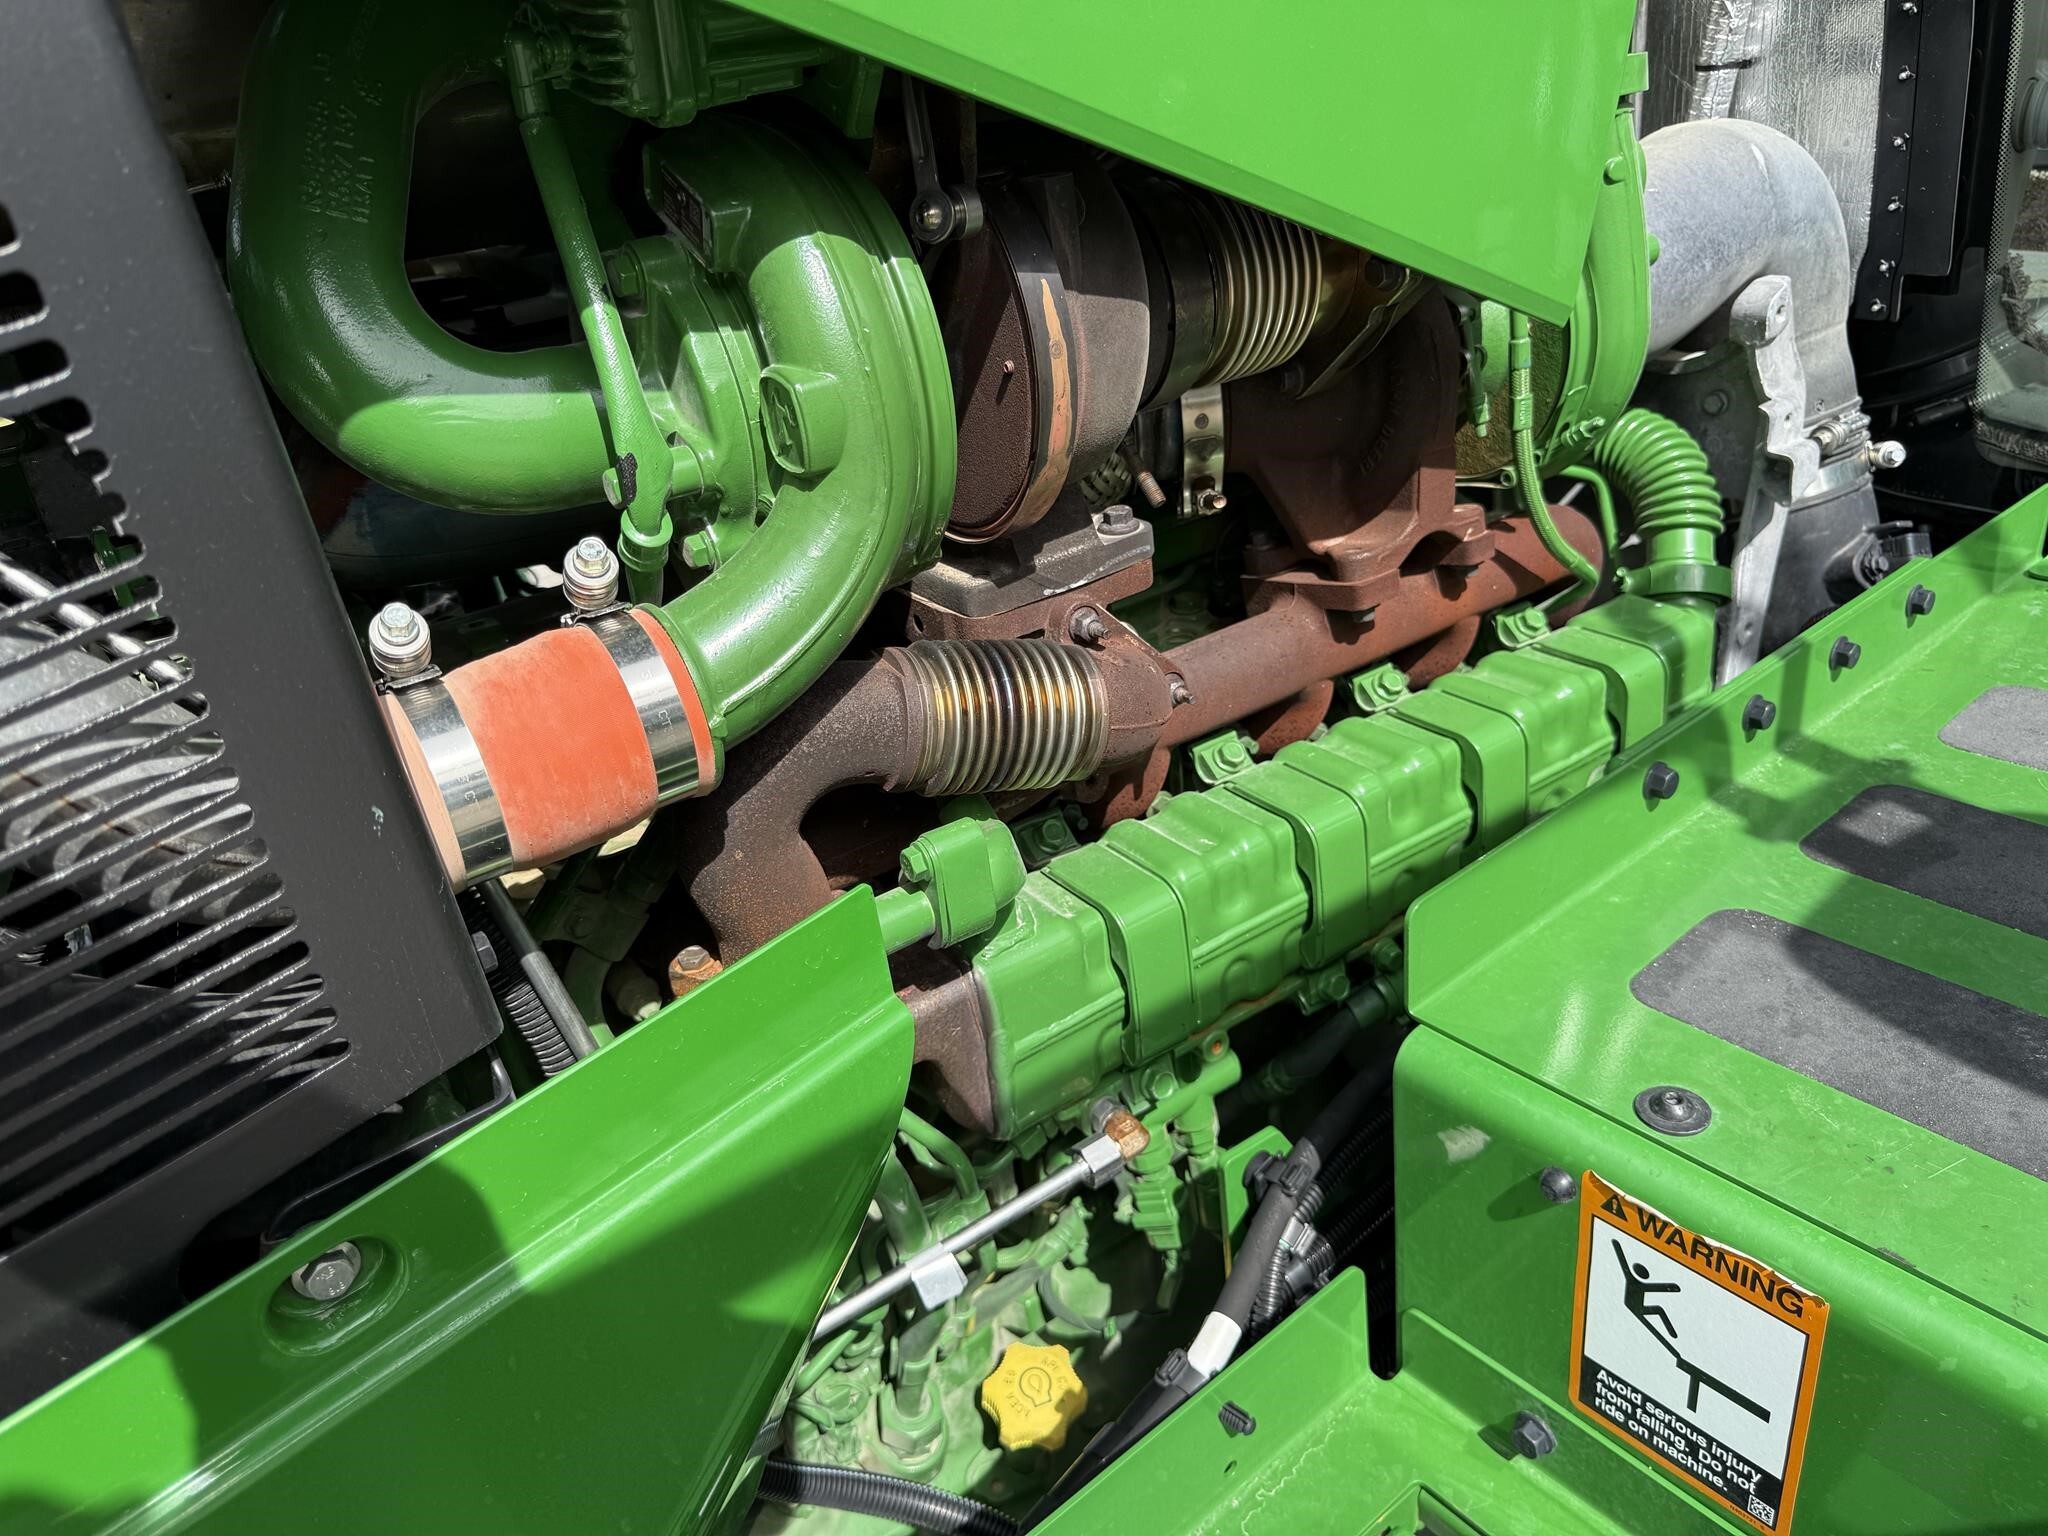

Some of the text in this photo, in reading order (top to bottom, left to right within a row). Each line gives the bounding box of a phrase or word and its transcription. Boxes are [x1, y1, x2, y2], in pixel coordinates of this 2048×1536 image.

[1636, 1207, 1804, 1319] WARNING
[1595, 1382, 1756, 1495] from falling. Do not
[1595, 1396, 1728, 1492] ride on machine.
[1596, 1369, 1762, 1483] Avoid serious injury
